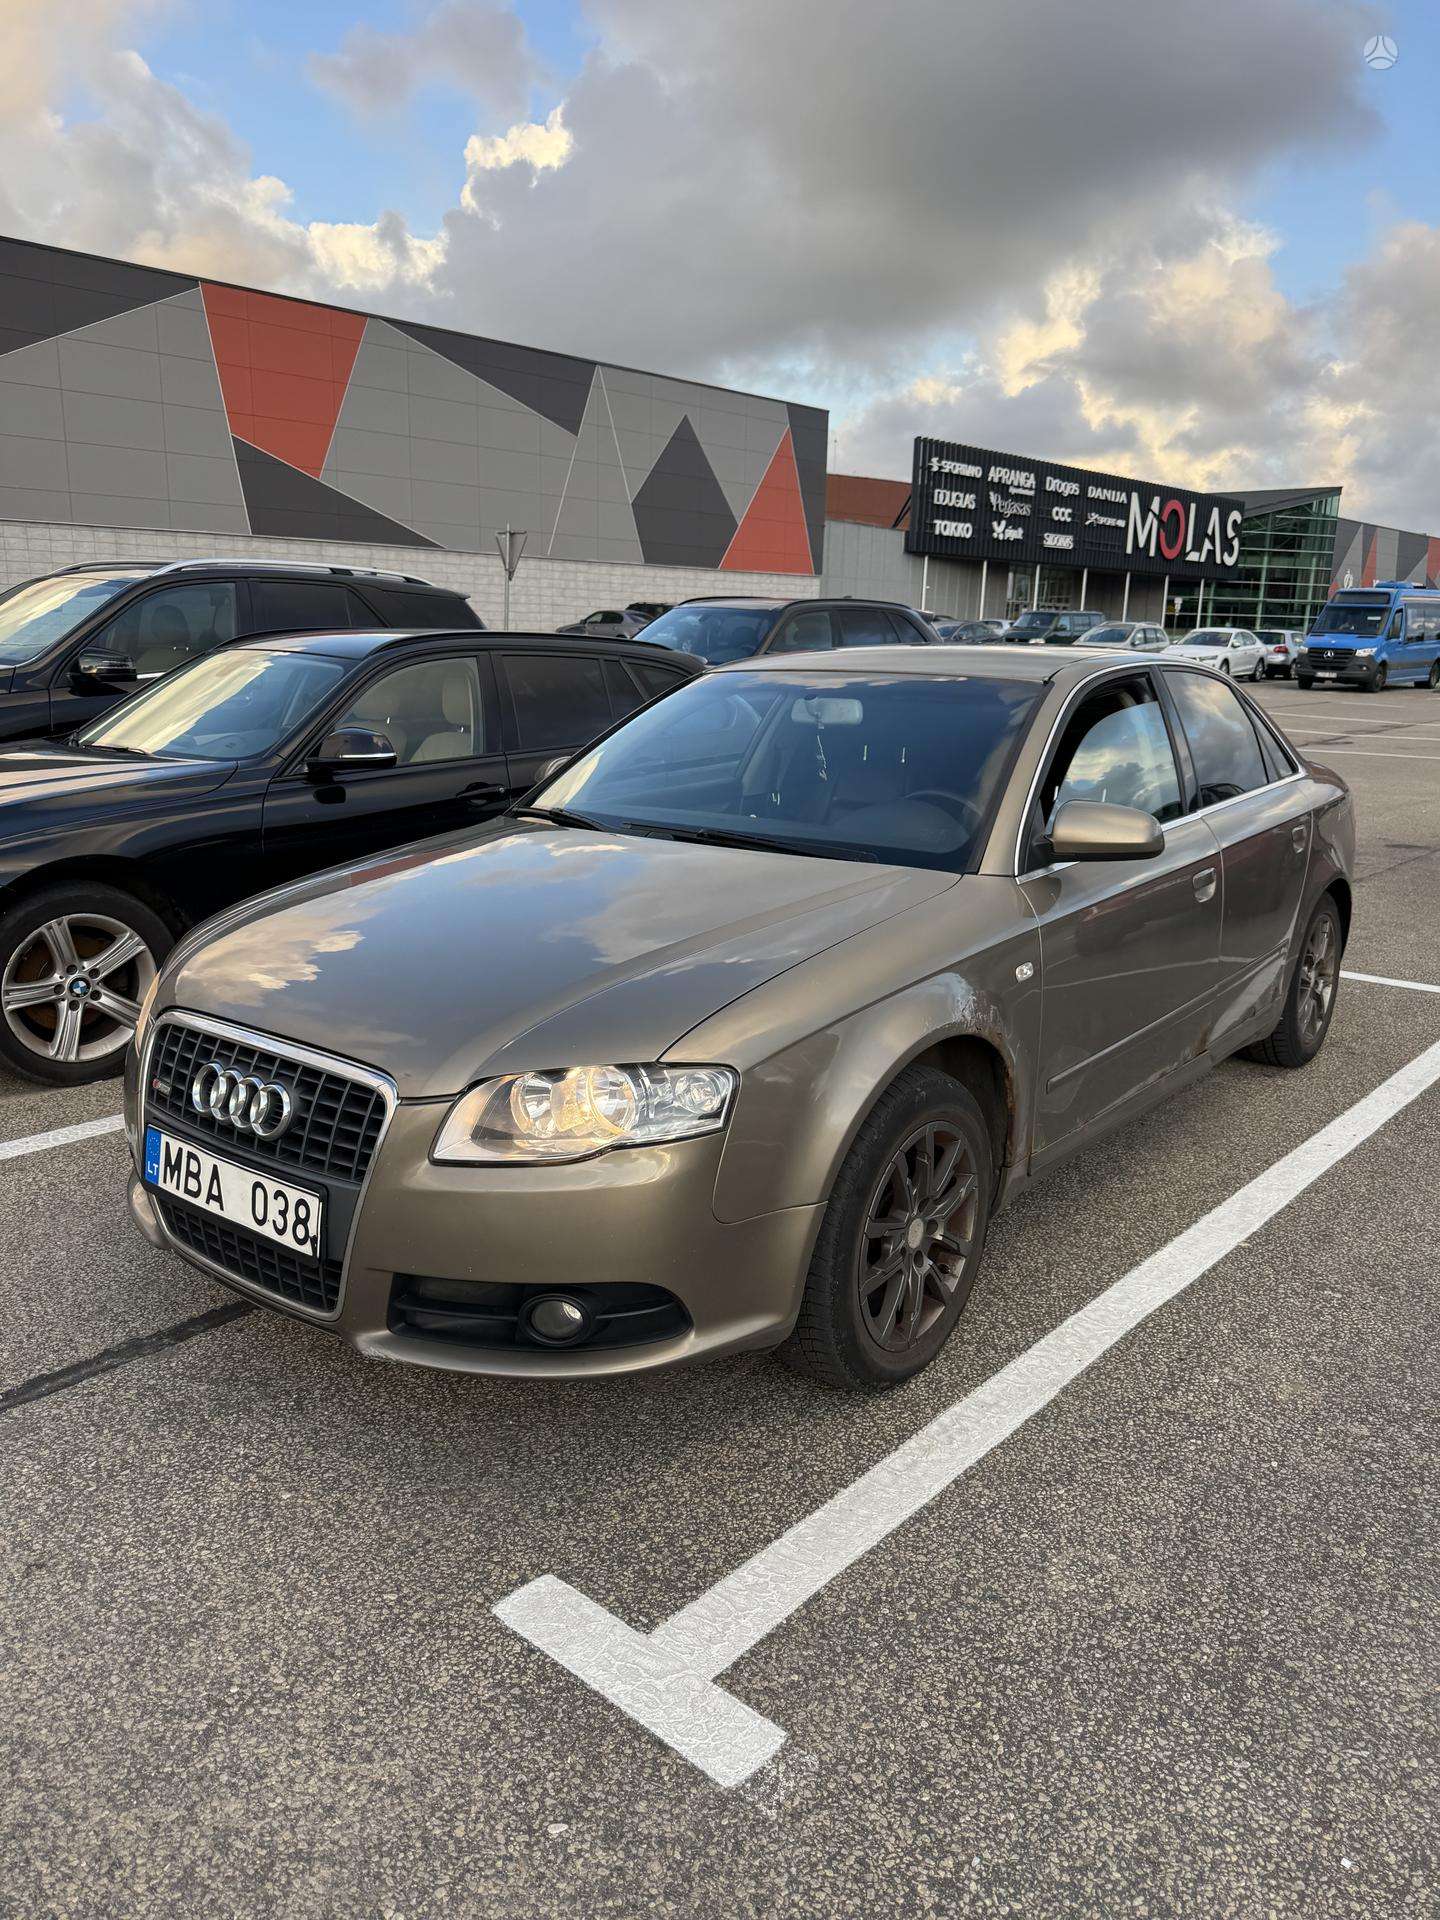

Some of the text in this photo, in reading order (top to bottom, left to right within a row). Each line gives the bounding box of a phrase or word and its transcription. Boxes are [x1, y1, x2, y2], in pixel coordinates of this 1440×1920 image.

[988, 466, 1036, 489] APRANGA
[1045, 476, 1080, 497] Drogas
[933, 488, 977, 510] DOUGLAS
[990, 491, 1032, 518] Pegasas
[1087, 486, 1127, 504] DANIJA
[1051, 506, 1073, 523] CCC
[1125, 491, 1242, 567] MOLAS
[147, 1160, 159, 1176] LT
[162, 1141, 311, 1246] MBA 038
